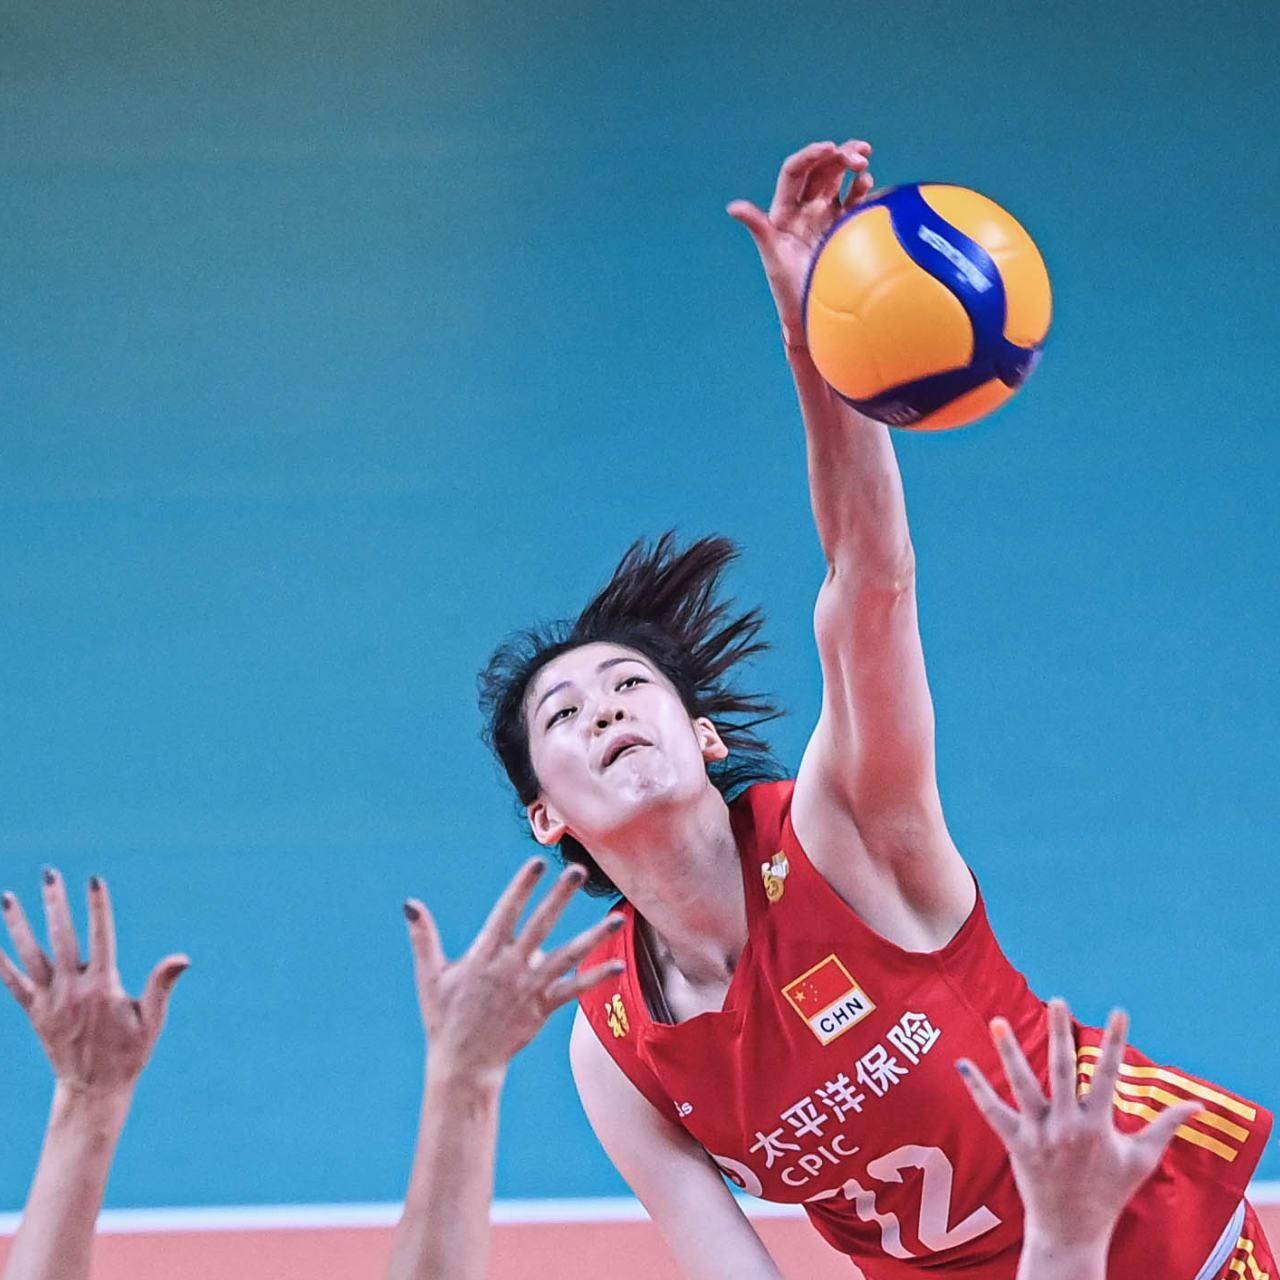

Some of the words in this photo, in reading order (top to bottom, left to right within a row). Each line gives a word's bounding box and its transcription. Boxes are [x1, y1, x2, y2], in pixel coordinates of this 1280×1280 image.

[820, 997, 864, 1034] CHN
[749, 1011, 942, 1170] 太平洋保险
[780, 1133, 860, 1187] CPIC
[803, 1144, 1003, 1260] 12
